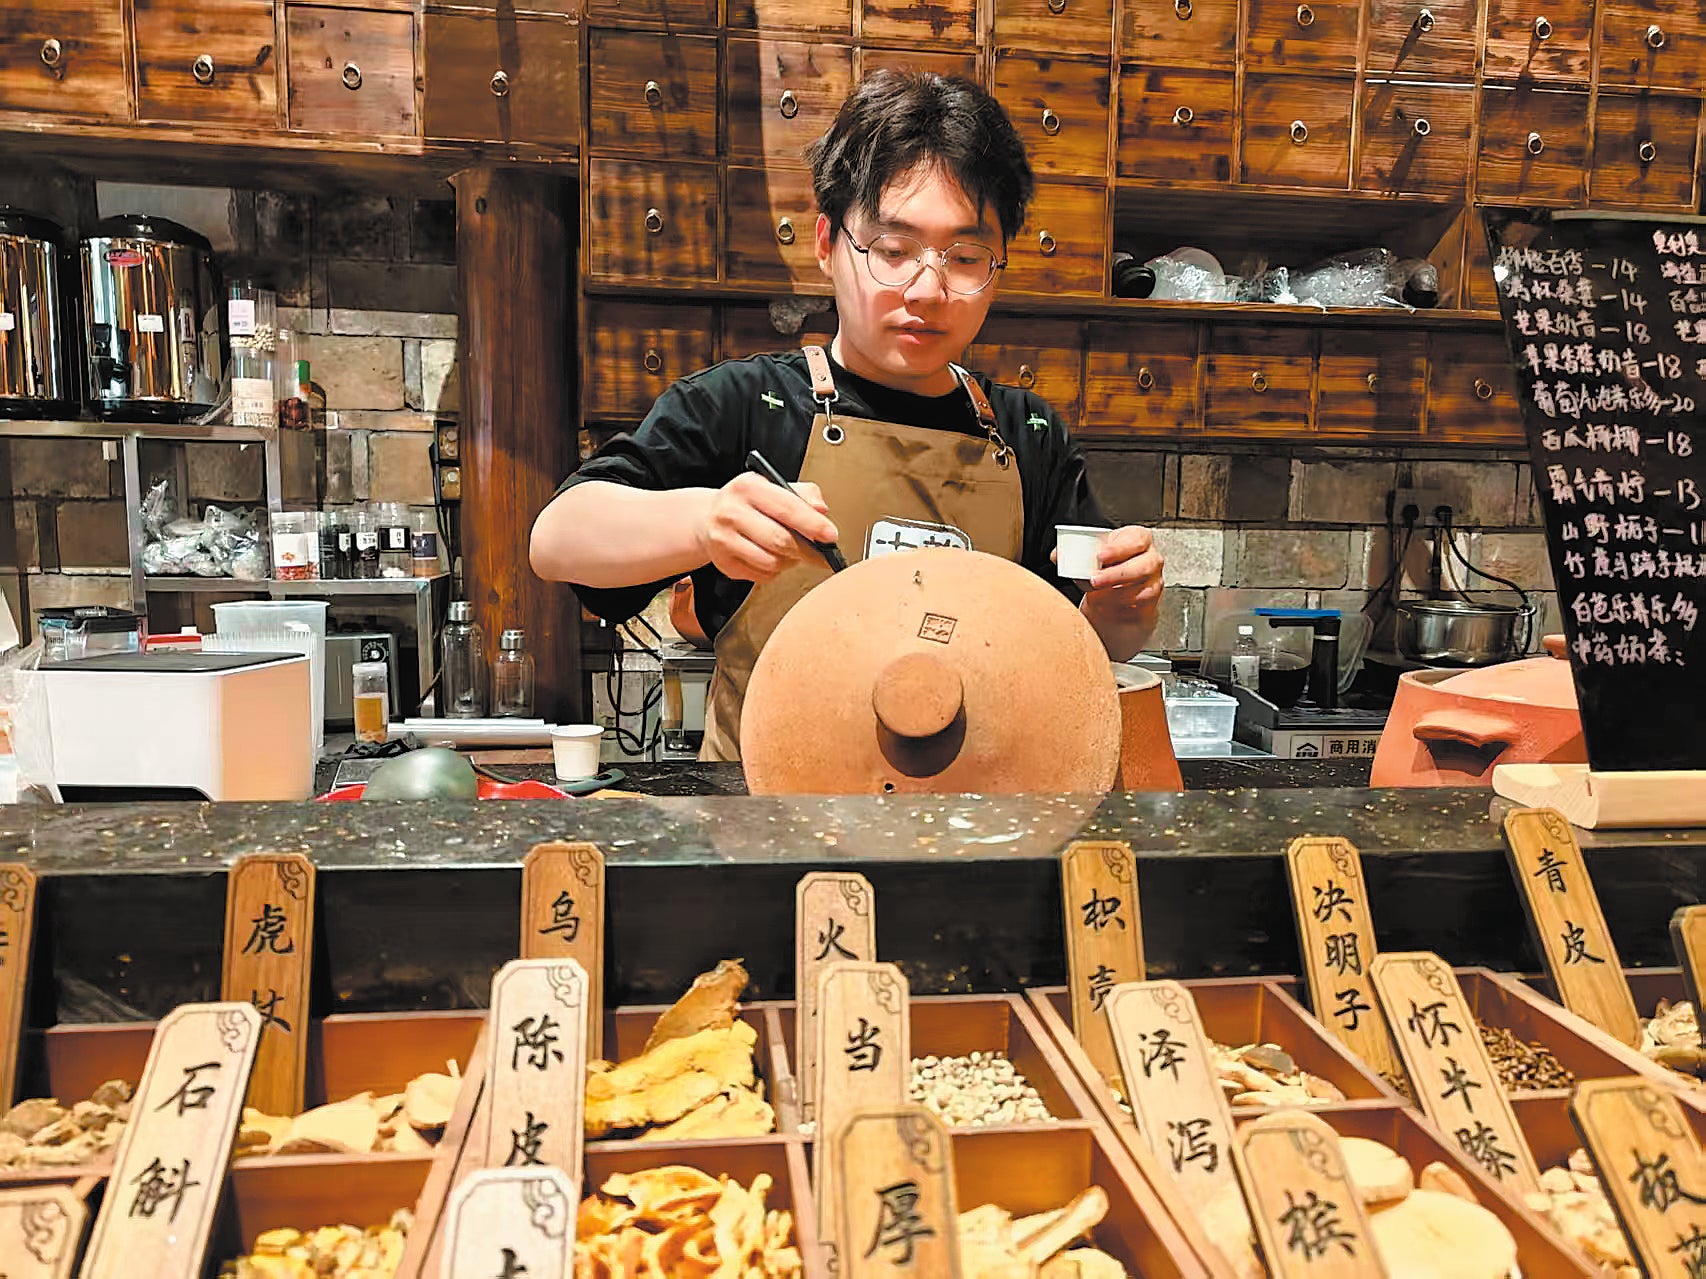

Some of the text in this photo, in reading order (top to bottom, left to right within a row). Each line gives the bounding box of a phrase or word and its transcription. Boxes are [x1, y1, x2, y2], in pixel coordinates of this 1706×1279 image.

[1080, 888, 1124, 1012] 枳壳
[1312, 879, 1371, 1030] 决明子
[1534, 847, 1605, 967] 青皮
[503, 1014, 565, 1167] 陈皮
[843, 1018, 884, 1073] 当
[1137, 1029, 1219, 1174] 泽泻
[1406, 998, 1516, 1180] 怀牛膝
[127, 1061, 222, 1225] 石斛
[864, 1181, 936, 1264] 厚
